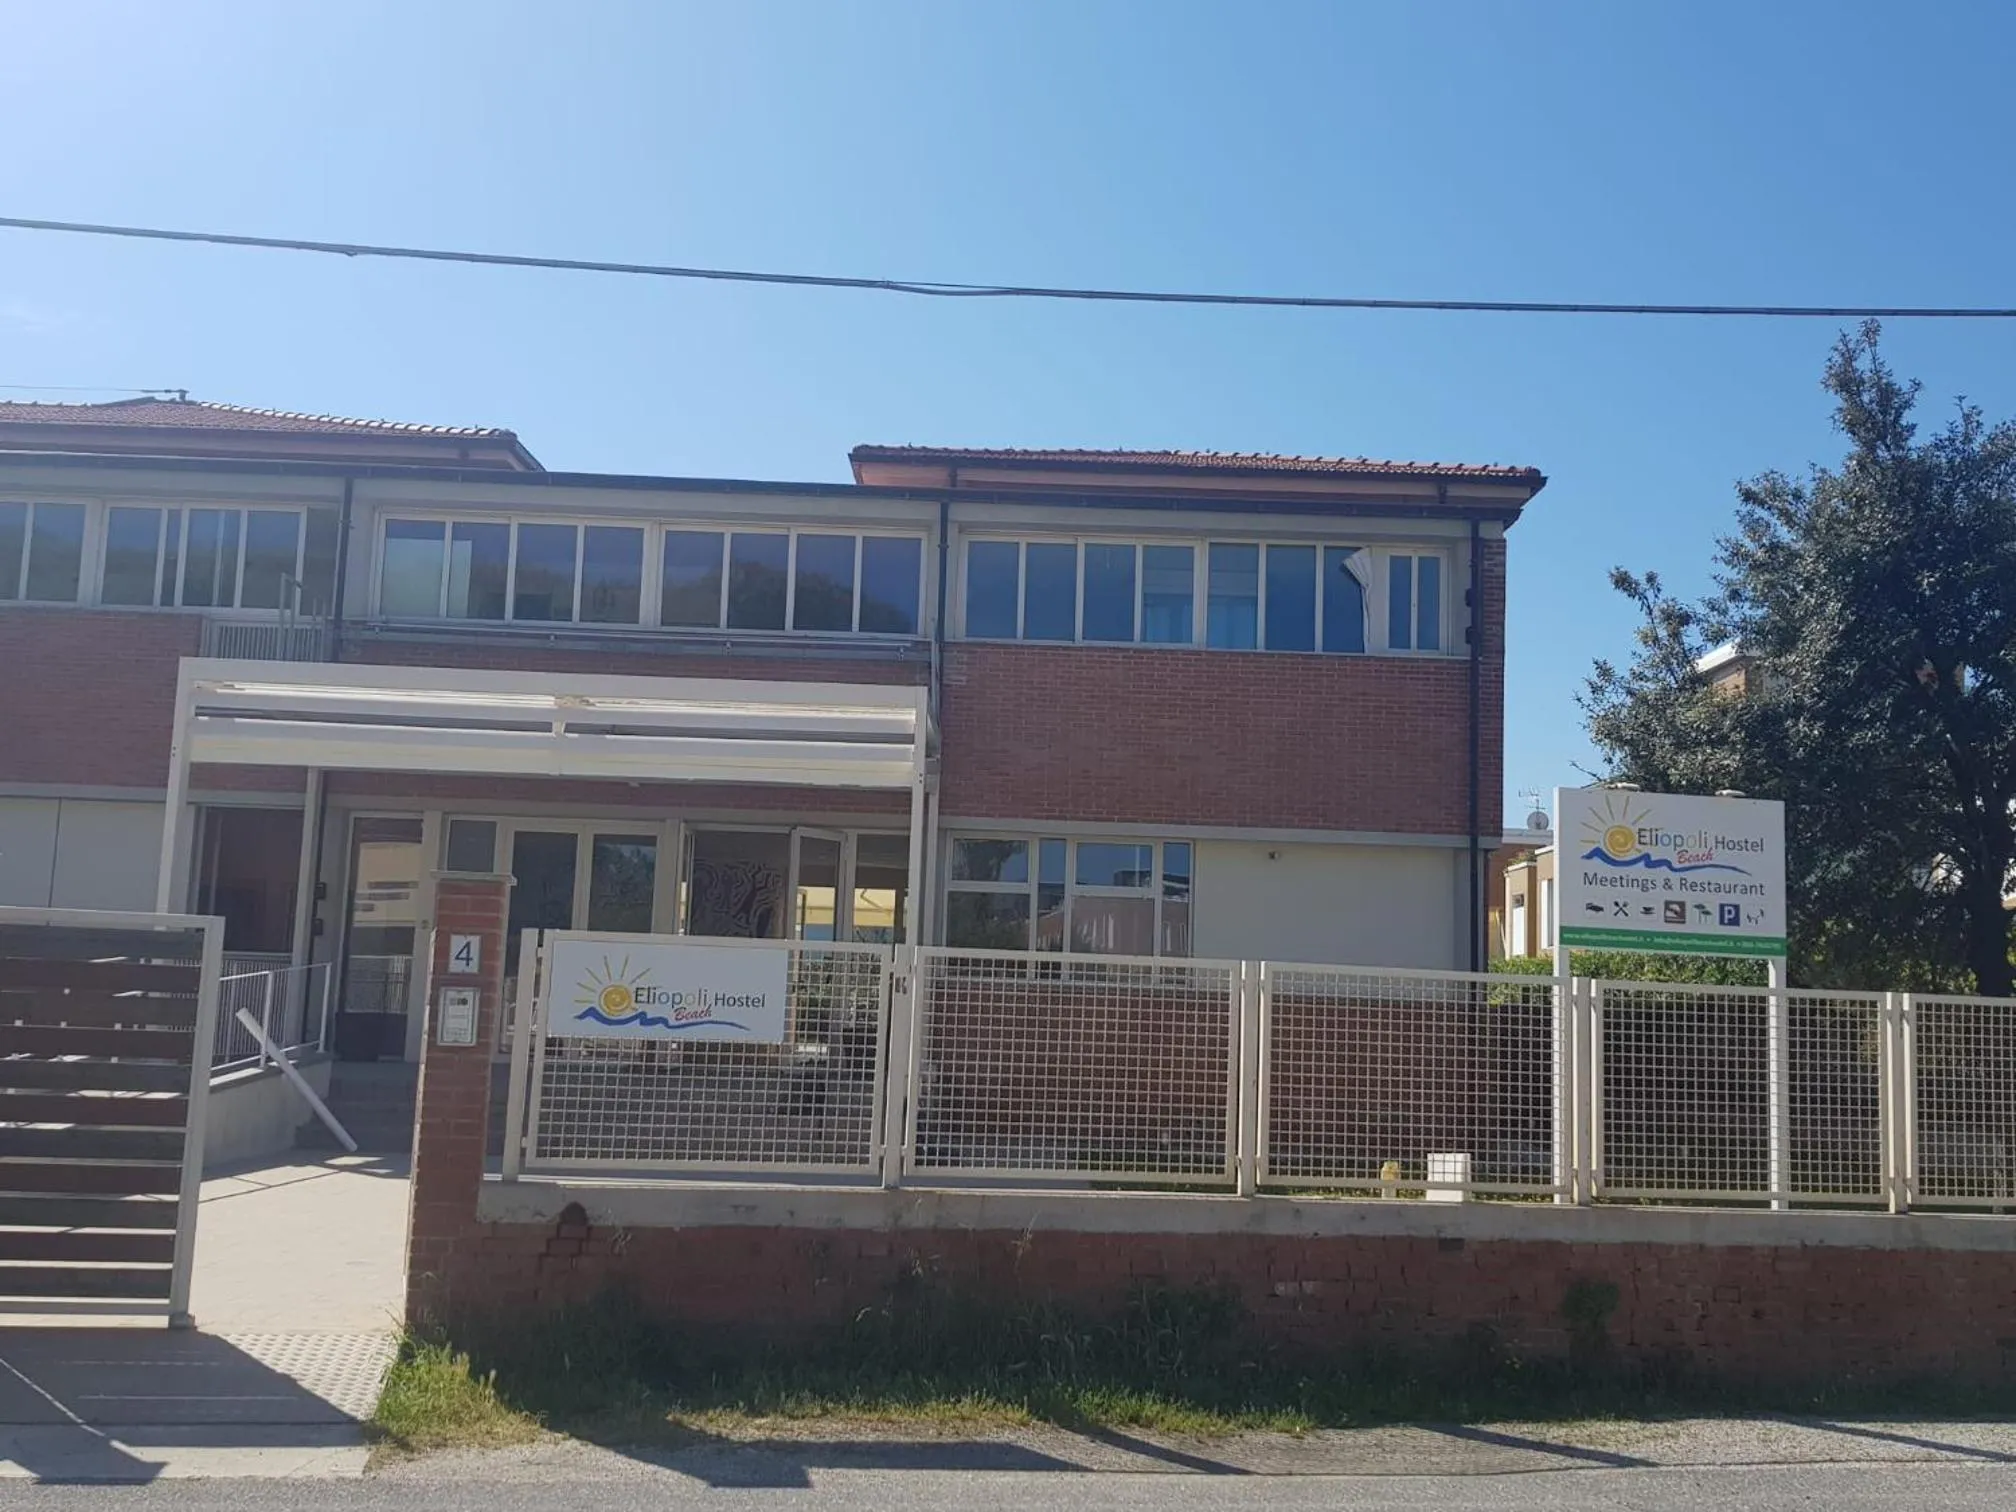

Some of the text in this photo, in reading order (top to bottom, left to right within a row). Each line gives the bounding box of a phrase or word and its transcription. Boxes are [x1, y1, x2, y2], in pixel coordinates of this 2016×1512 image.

[1637, 827, 1765, 853] Eliopoli Hostel
[1676, 847, 1714, 865] Beach
[1583, 872, 1765, 896] Meetings & Restaurant
[1723, 906, 1735, 924] P
[454, 940, 473, 966] 4
[634, 986, 766, 1009] Eliopoli Hostel
[673, 1003, 713, 1022] Beach
